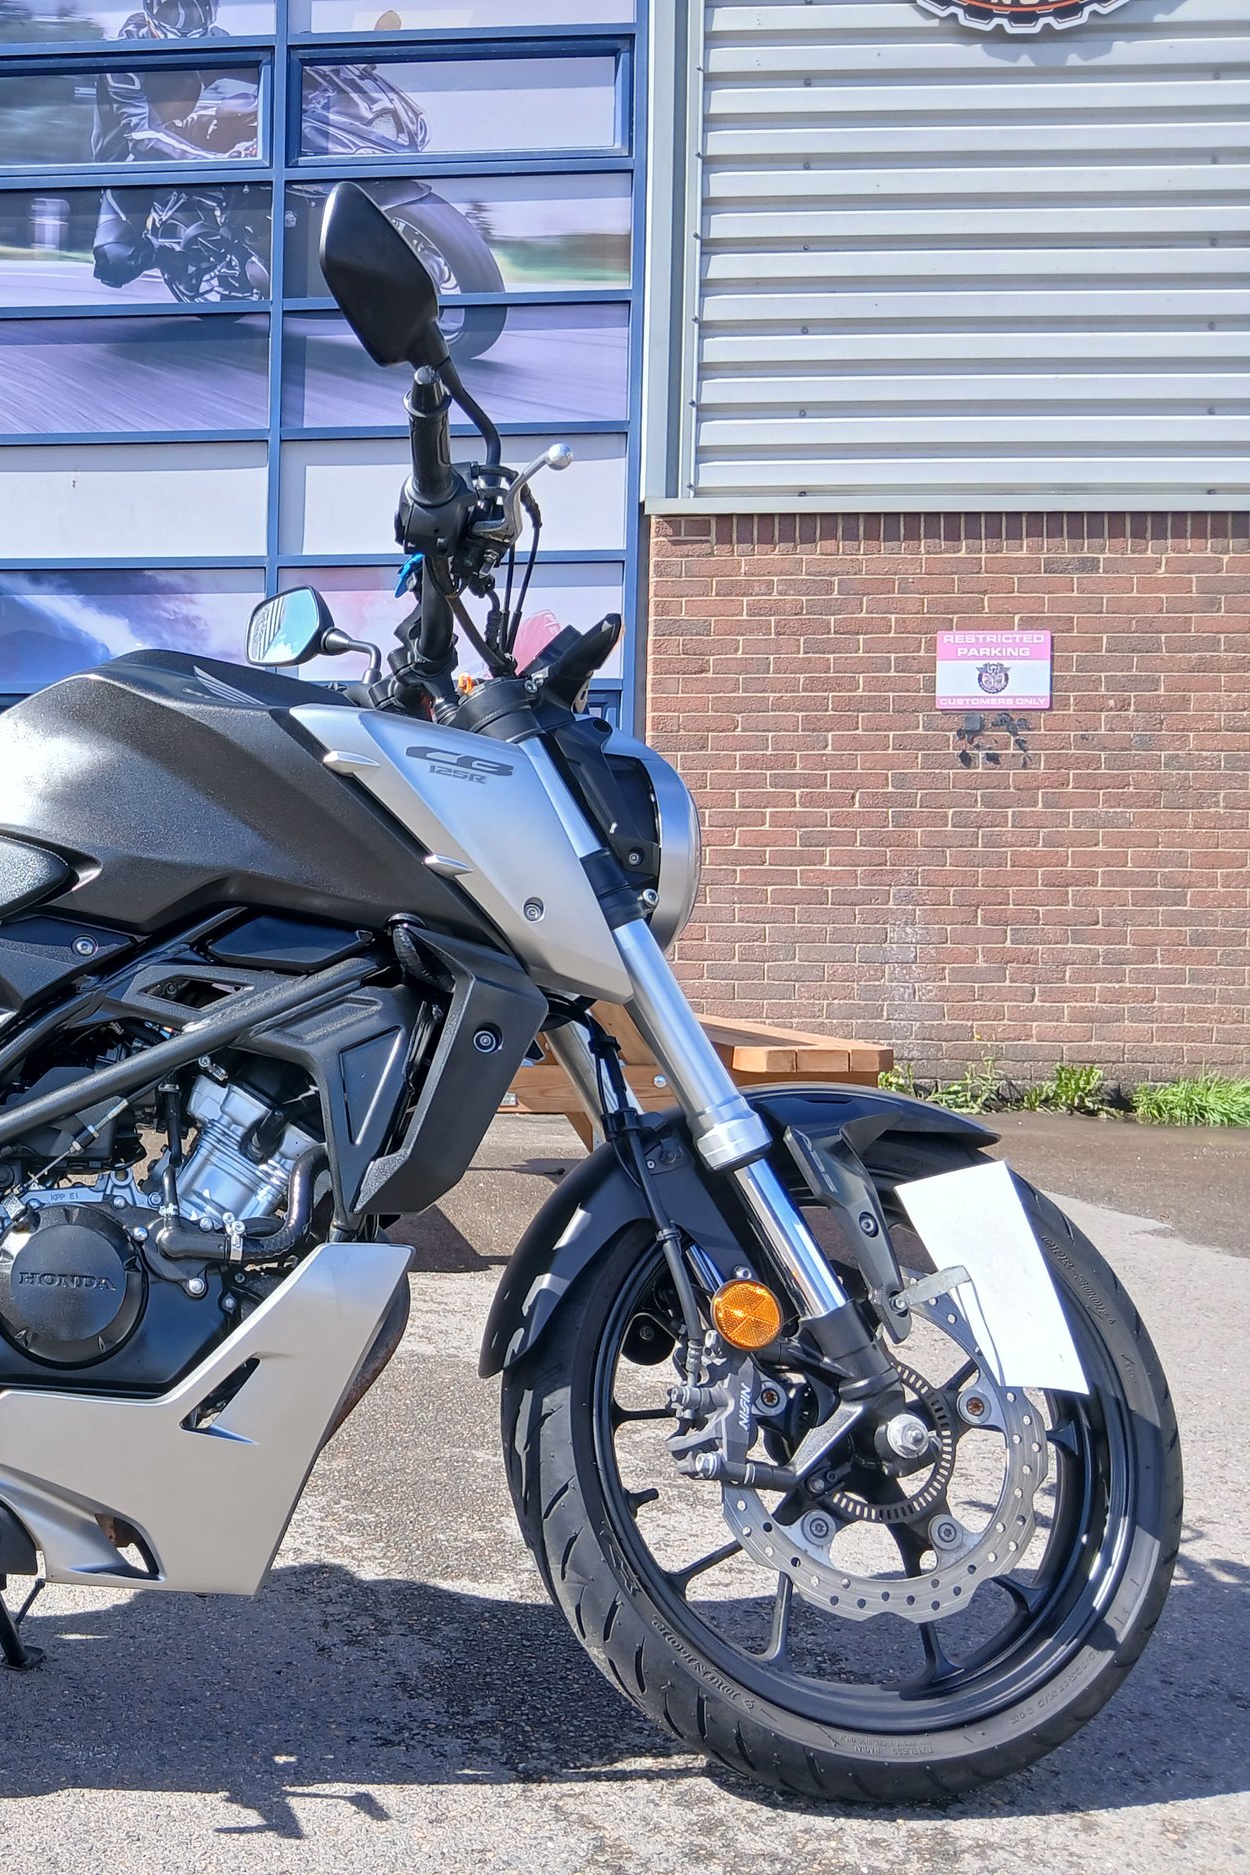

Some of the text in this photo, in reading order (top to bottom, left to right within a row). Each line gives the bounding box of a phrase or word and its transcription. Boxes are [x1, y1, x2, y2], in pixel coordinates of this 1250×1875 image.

[943, 634, 1045, 643] RESTRICTED
[957, 647, 1031, 656] PARKING
[406, 746, 514, 776] CB
[429, 765, 487, 785] 125R
[18, 1271, 116, 1291] HONDA
